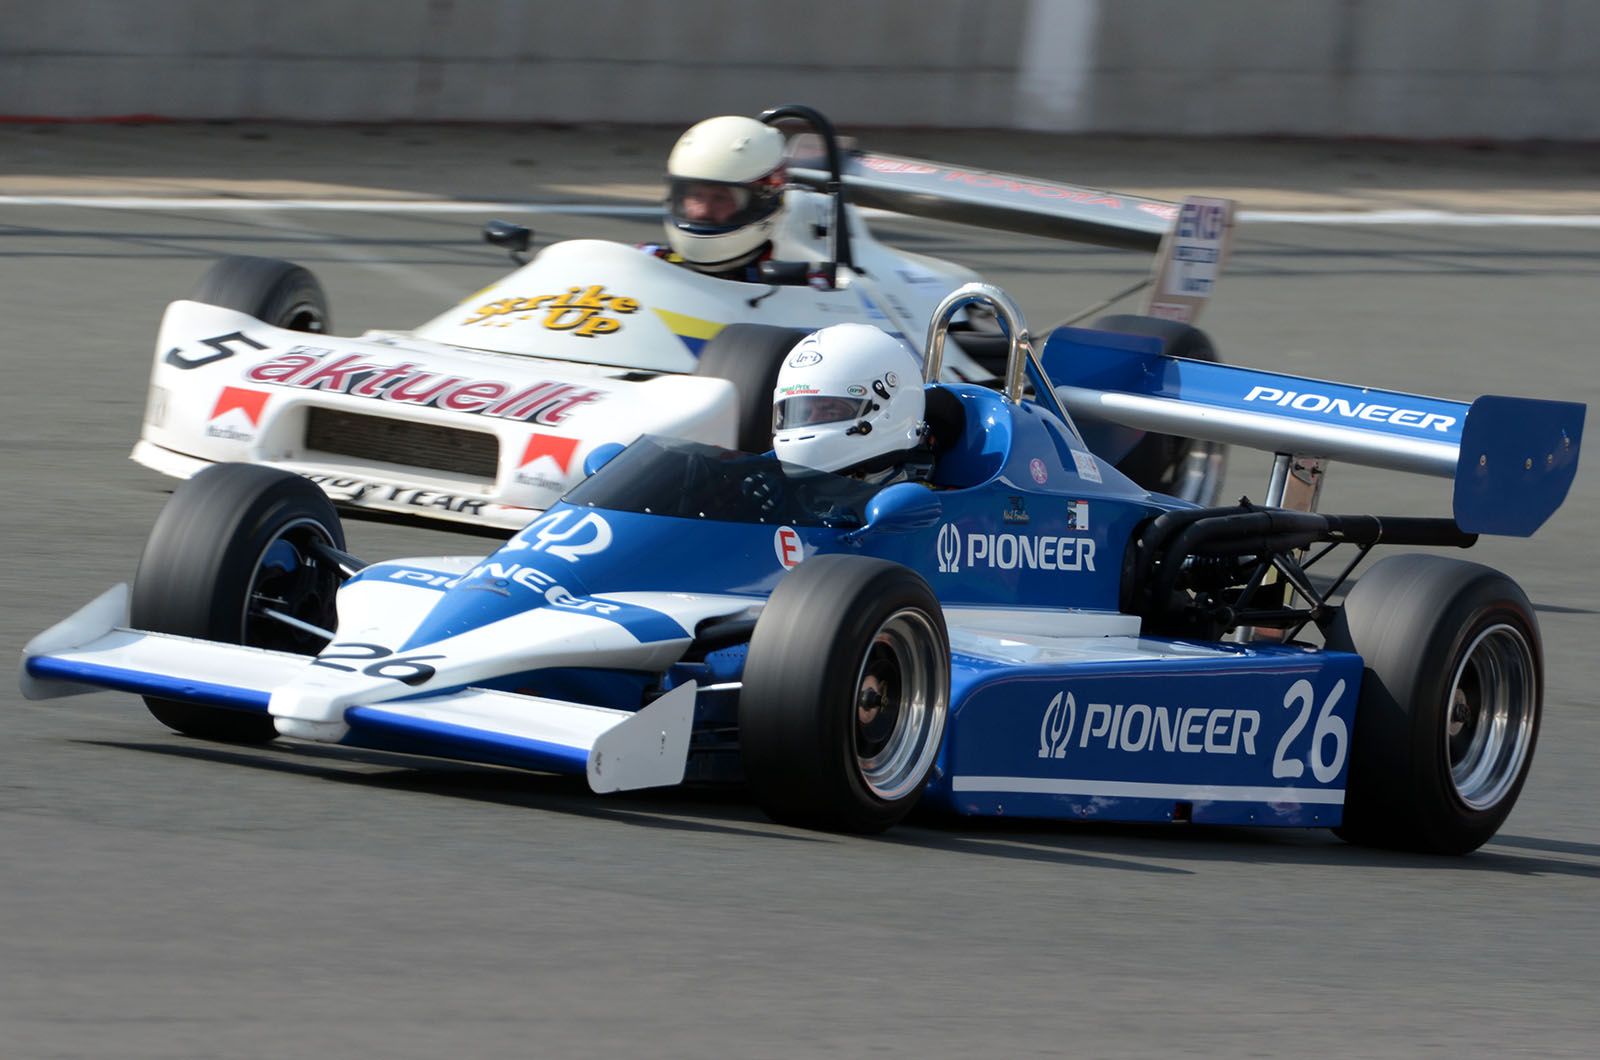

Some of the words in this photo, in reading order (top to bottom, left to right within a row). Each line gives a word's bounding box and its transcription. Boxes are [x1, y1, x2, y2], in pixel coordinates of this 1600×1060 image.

[542, 308, 622, 337] Up
[164, 330, 272, 370] 5
[245, 353, 606, 426] aktuellt
[1244, 386, 1456, 431] PIONEER
[780, 531, 799, 566] E
[967, 532, 1096, 572] PIONEER
[389, 562, 622, 615] PIONEER
[311, 641, 446, 686] 26
[1079, 702, 1261, 756] PIONEER
[1272, 679, 1348, 784] 26
